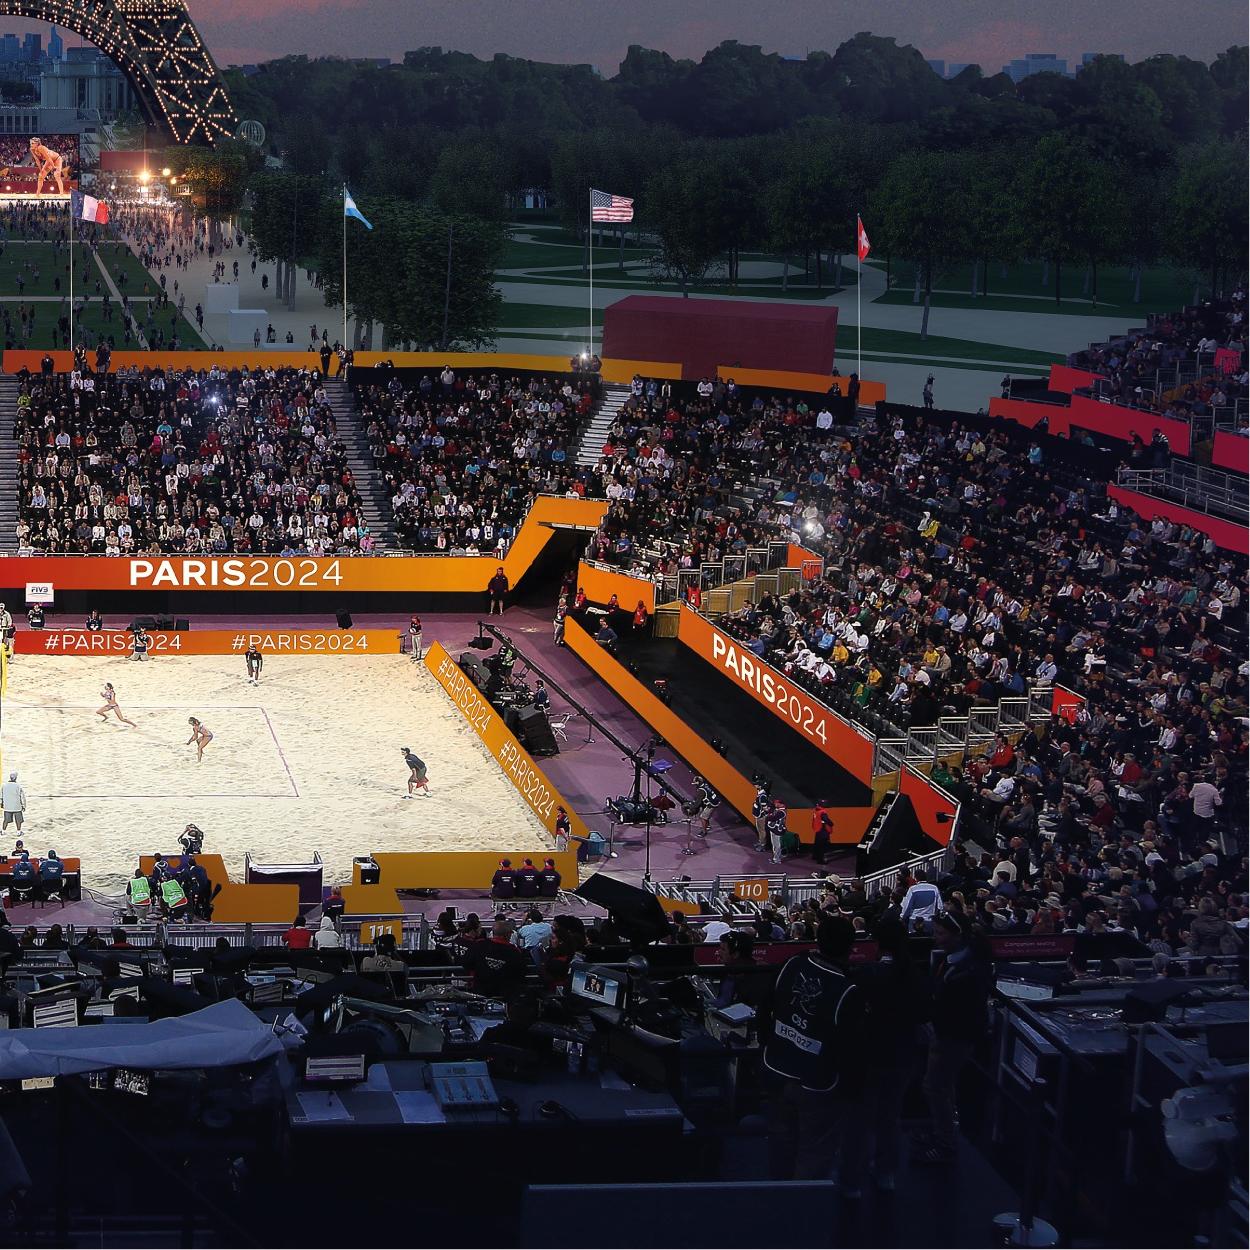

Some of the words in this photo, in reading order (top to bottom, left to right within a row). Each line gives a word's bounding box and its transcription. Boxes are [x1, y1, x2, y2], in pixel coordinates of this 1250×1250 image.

[130, 560, 344, 587] PARIS2024
[231, 634, 368, 651] #PARIS2024
[436, 656, 493, 735] #PARIS2024
[712, 632, 828, 747] PARIS2024
[497, 739, 556, 821] #PARIS2024
[739, 883, 763, 897] 110
